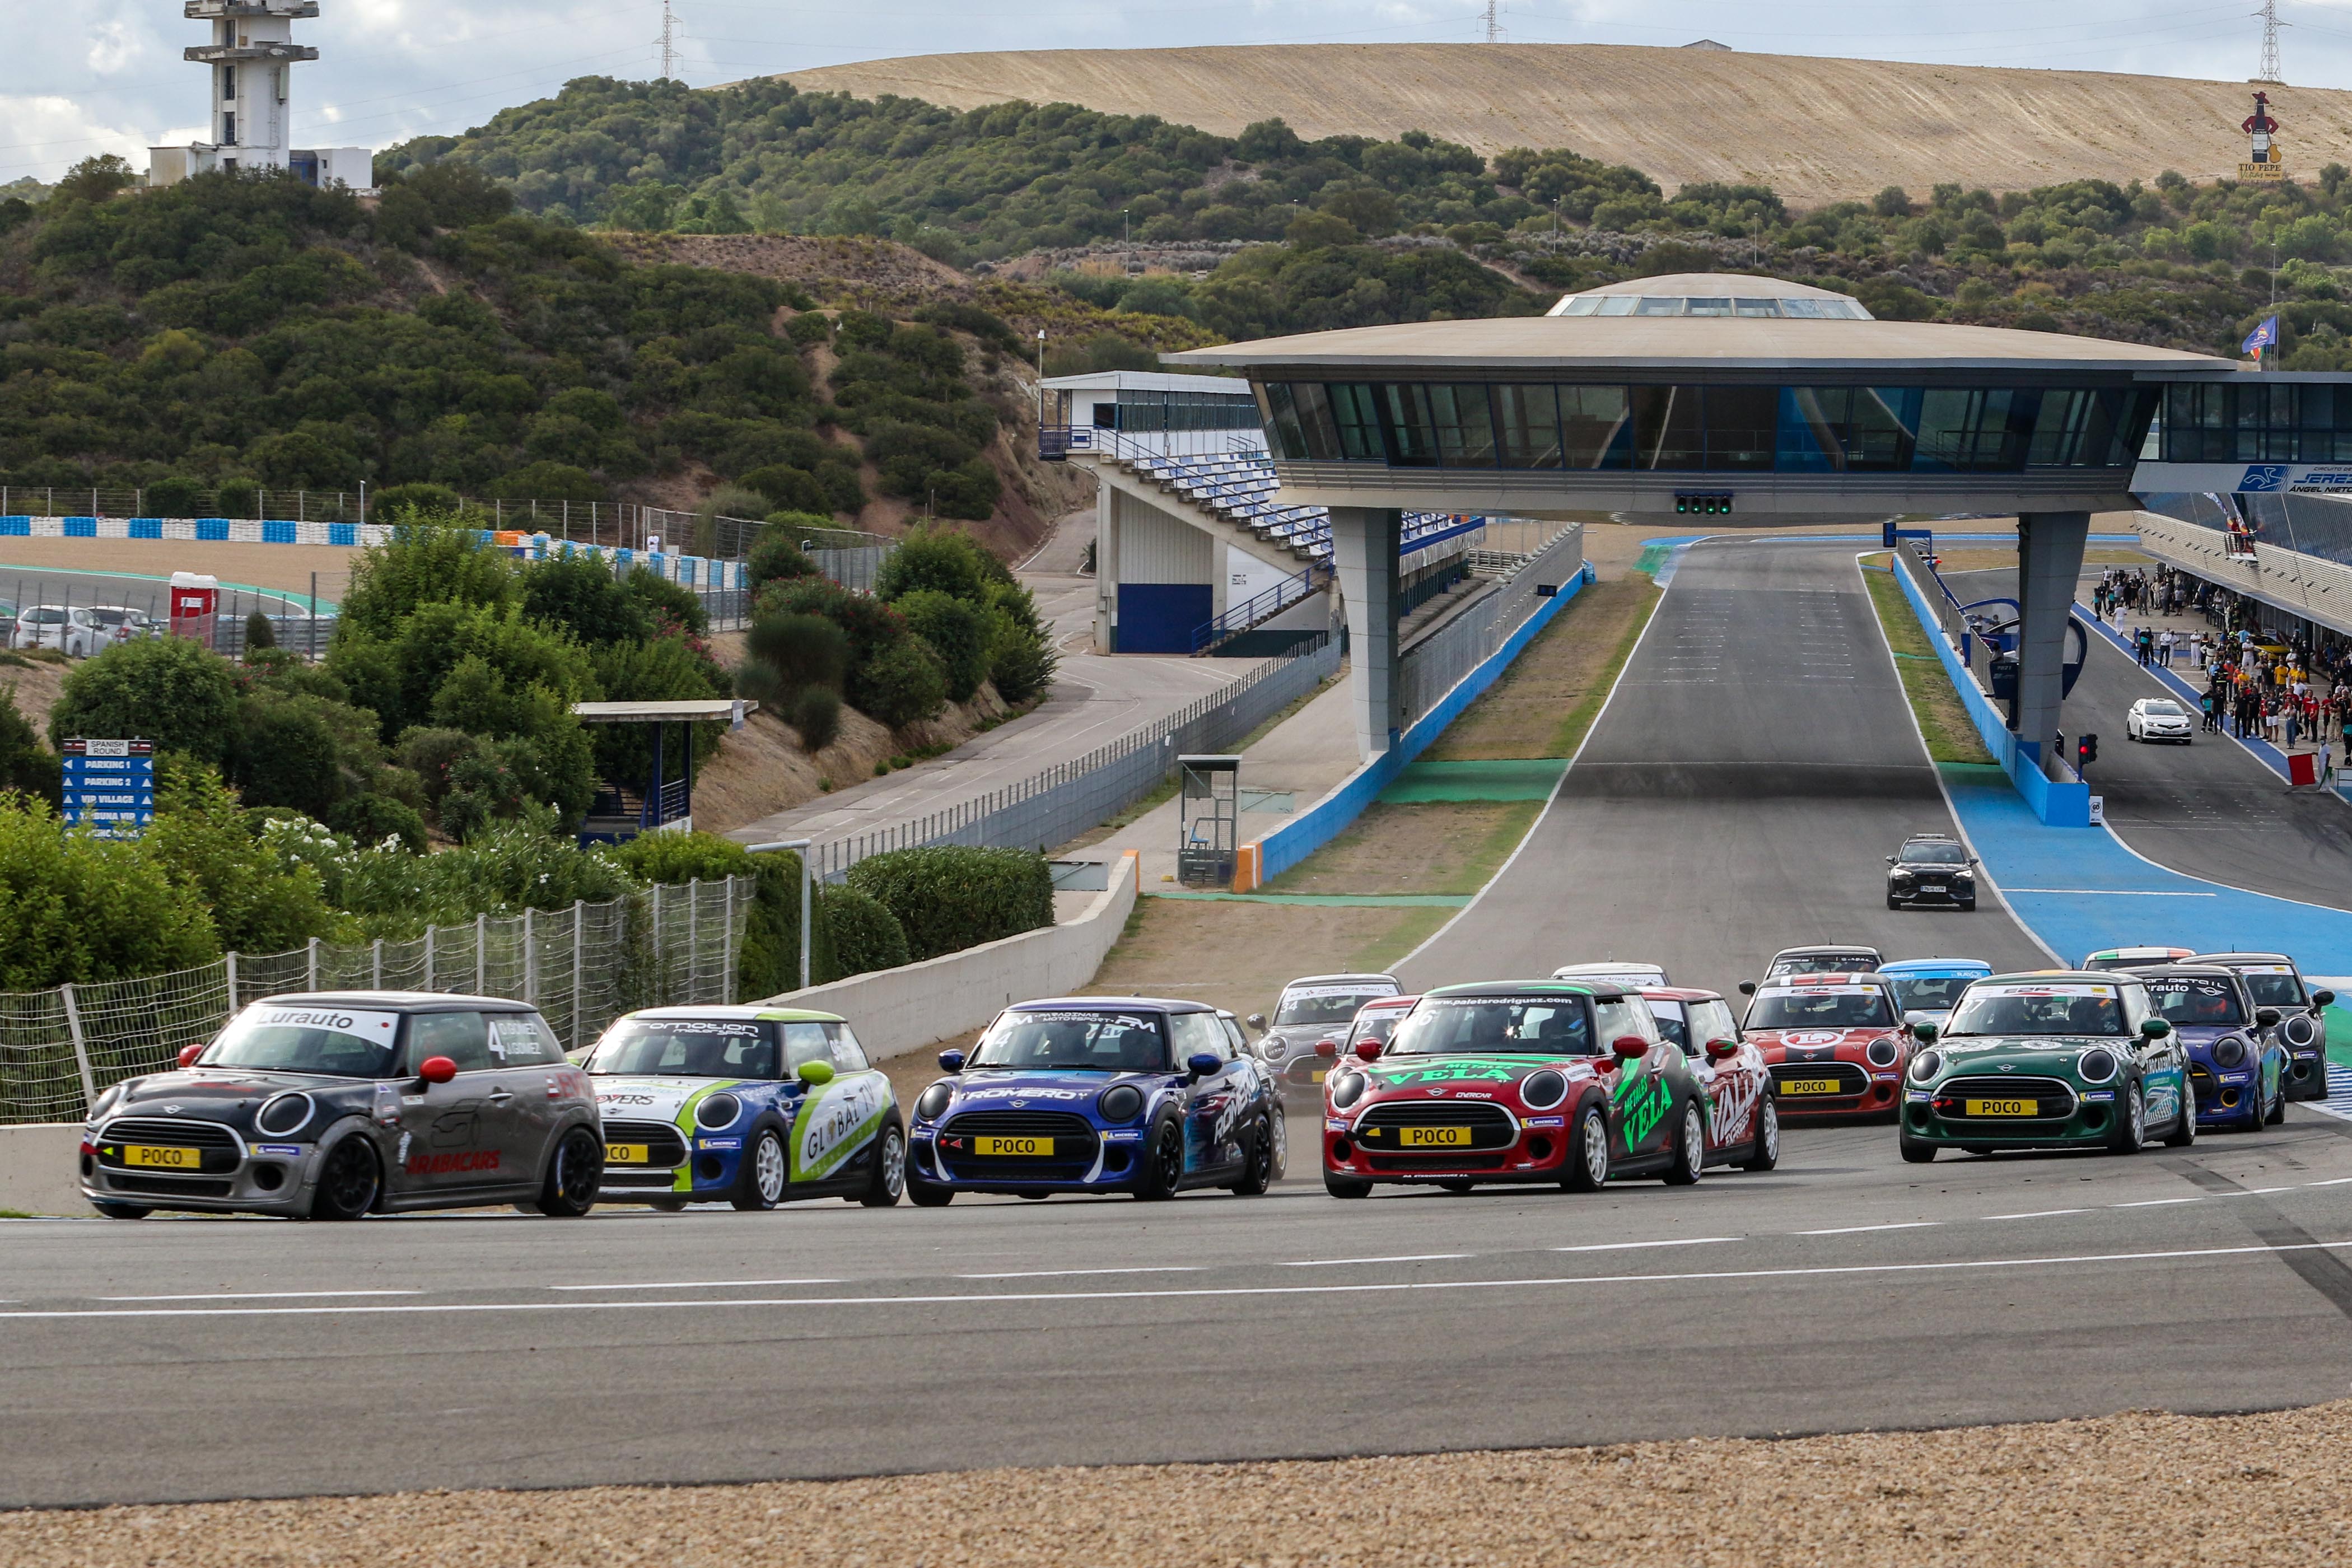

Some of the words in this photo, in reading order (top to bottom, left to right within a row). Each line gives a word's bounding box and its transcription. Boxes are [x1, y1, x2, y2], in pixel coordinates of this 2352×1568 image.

[85, 760, 124, 769] PARKING
[125, 778, 131, 786] 2
[99, 795, 134, 804] VILLAGE
[120, 813, 136, 821] VIP
[1772, 964, 1791, 974] 22
[1280, 1001, 1298, 1014] 34
[1960, 998, 1986, 1014] 27
[256, 1011, 353, 1029] Lurauto
[673, 1029, 758, 1038] motorsport
[1355, 1020, 1375, 1035] 12
[488, 1021, 506, 1060] 4
[1385, 1069, 1513, 1085] VELA
[1794, 1081, 1826, 1092] POCO
[858, 1080, 876, 1113] TV
[967, 1089, 1077, 1100] ROMERO
[1623, 1074, 1648, 1118] METALES
[1214, 1069, 1260, 1145] ROMERO
[1982, 1102, 2021, 1113] POCO
[1623, 1077, 1673, 1154] VELA
[1413, 1130, 1457, 1144] POCO
[604, 1146, 629, 1160] CO
[993, 1140, 1035, 1153] POCO
[142, 1148, 182, 1165] POCO
[405, 1150, 502, 1174] ARABACARS
